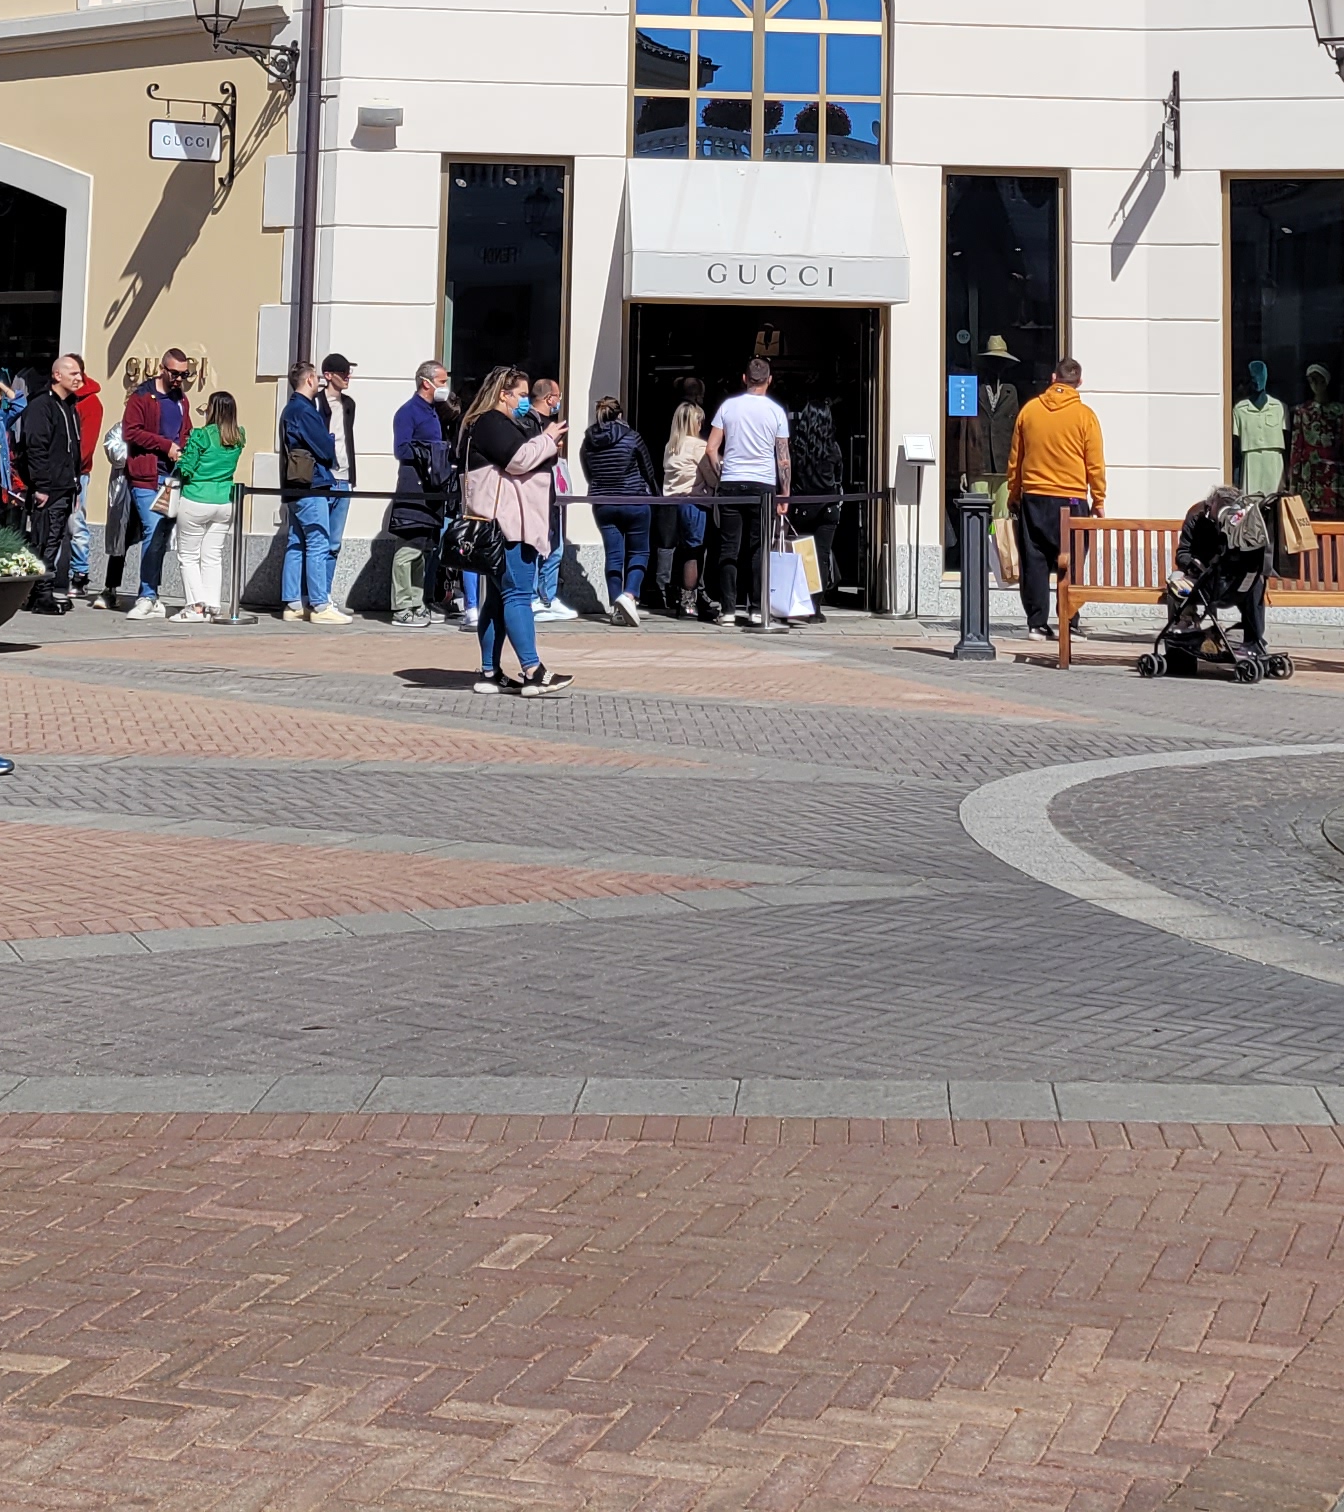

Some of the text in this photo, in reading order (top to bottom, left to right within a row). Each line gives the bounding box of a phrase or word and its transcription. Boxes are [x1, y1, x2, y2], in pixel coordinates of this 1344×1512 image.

[162, 135, 211, 149] GUCCI
[707, 263, 834, 288] GUCCI
[125, 356, 209, 379] GUCI
